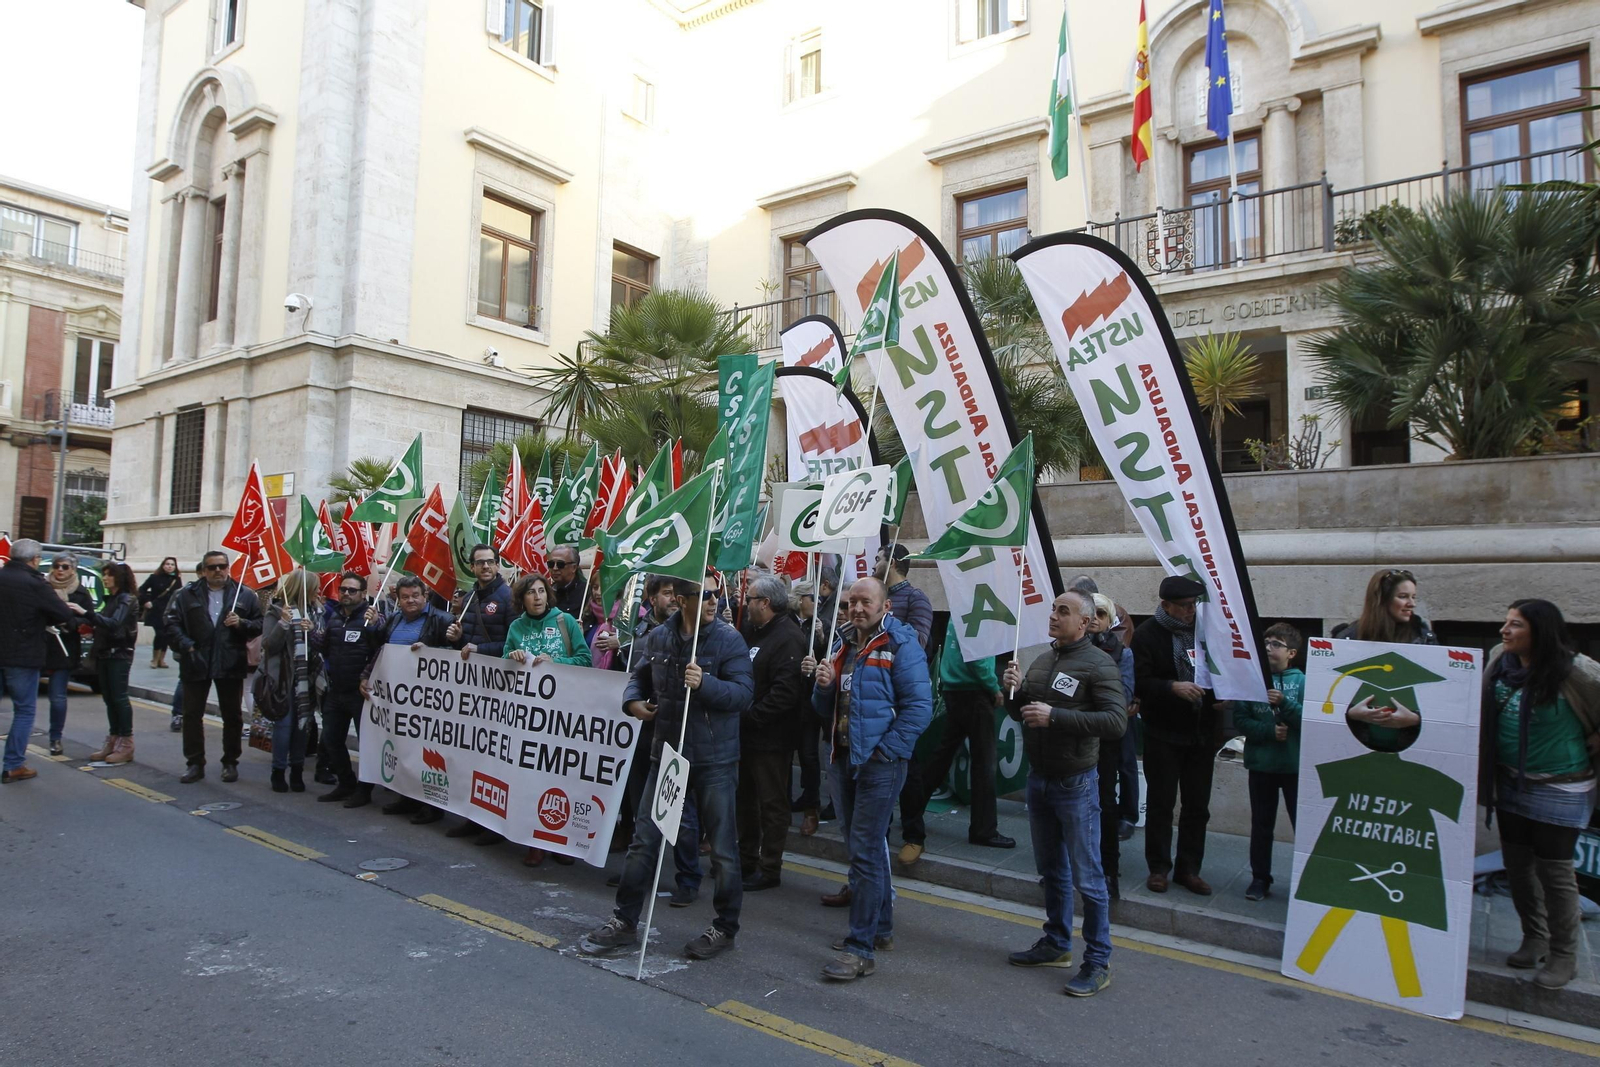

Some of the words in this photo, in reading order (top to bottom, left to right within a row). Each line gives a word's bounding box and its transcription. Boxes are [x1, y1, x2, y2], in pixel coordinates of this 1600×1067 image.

[1173, 308, 1213, 329] DEL
[417, 657, 450, 682] POR
[455, 662, 478, 687] UN
[482, 665, 557, 700] MODELO
[1449, 661, 1476, 670] USTEA
[386, 682, 454, 712] ACCESO
[458, 692, 634, 749] EXTRAORDINARIO
[394, 712, 498, 758] ESTABILICE
[500, 733, 513, 765] EL
[421, 770, 450, 788] USTEA
[474, 778, 507, 811] CCOO
[541, 793, 567, 814] UGT
[1347, 793, 1370, 811] NO
[1372, 796, 1413, 816] SOY
[1332, 816, 1436, 850] RECORTABLE
